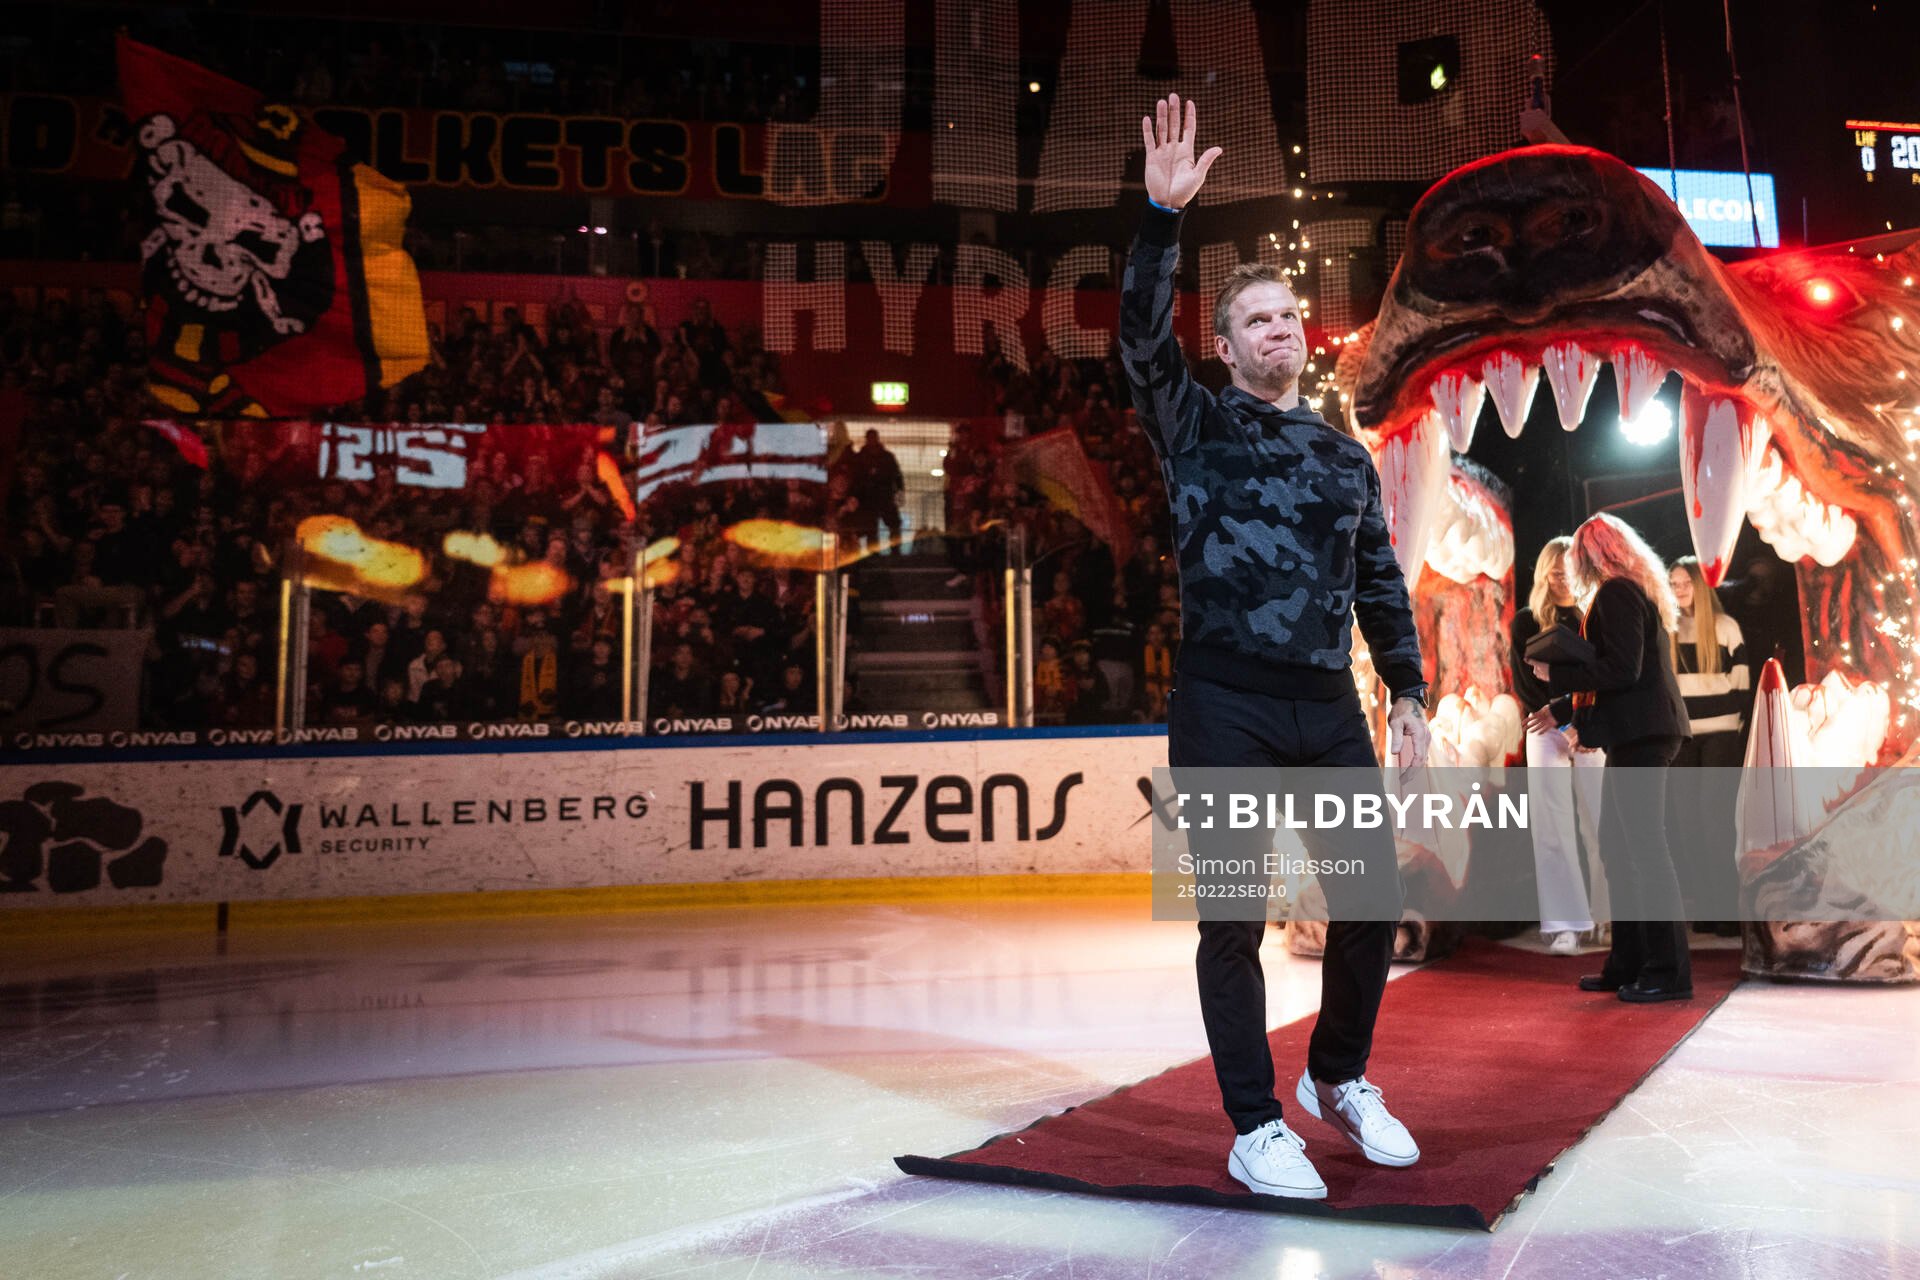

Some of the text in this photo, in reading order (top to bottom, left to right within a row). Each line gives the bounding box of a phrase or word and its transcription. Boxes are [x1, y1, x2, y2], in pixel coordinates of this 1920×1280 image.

[1676, 197, 1766, 222] LECOM
[672, 718, 733, 733] NYAB
[849, 713, 909, 729] NYAB
[940, 712, 999, 727] NYAB
[229, 729, 274, 744] NYA
[293, 727, 358, 742] NYAB
[395, 724, 458, 740] NYAB
[485, 722, 550, 738] NYAB
[130, 731, 197, 746] NYAB
[319, 796, 648, 829] WALLENBERG
[320, 837, 431, 854] SECURITY
